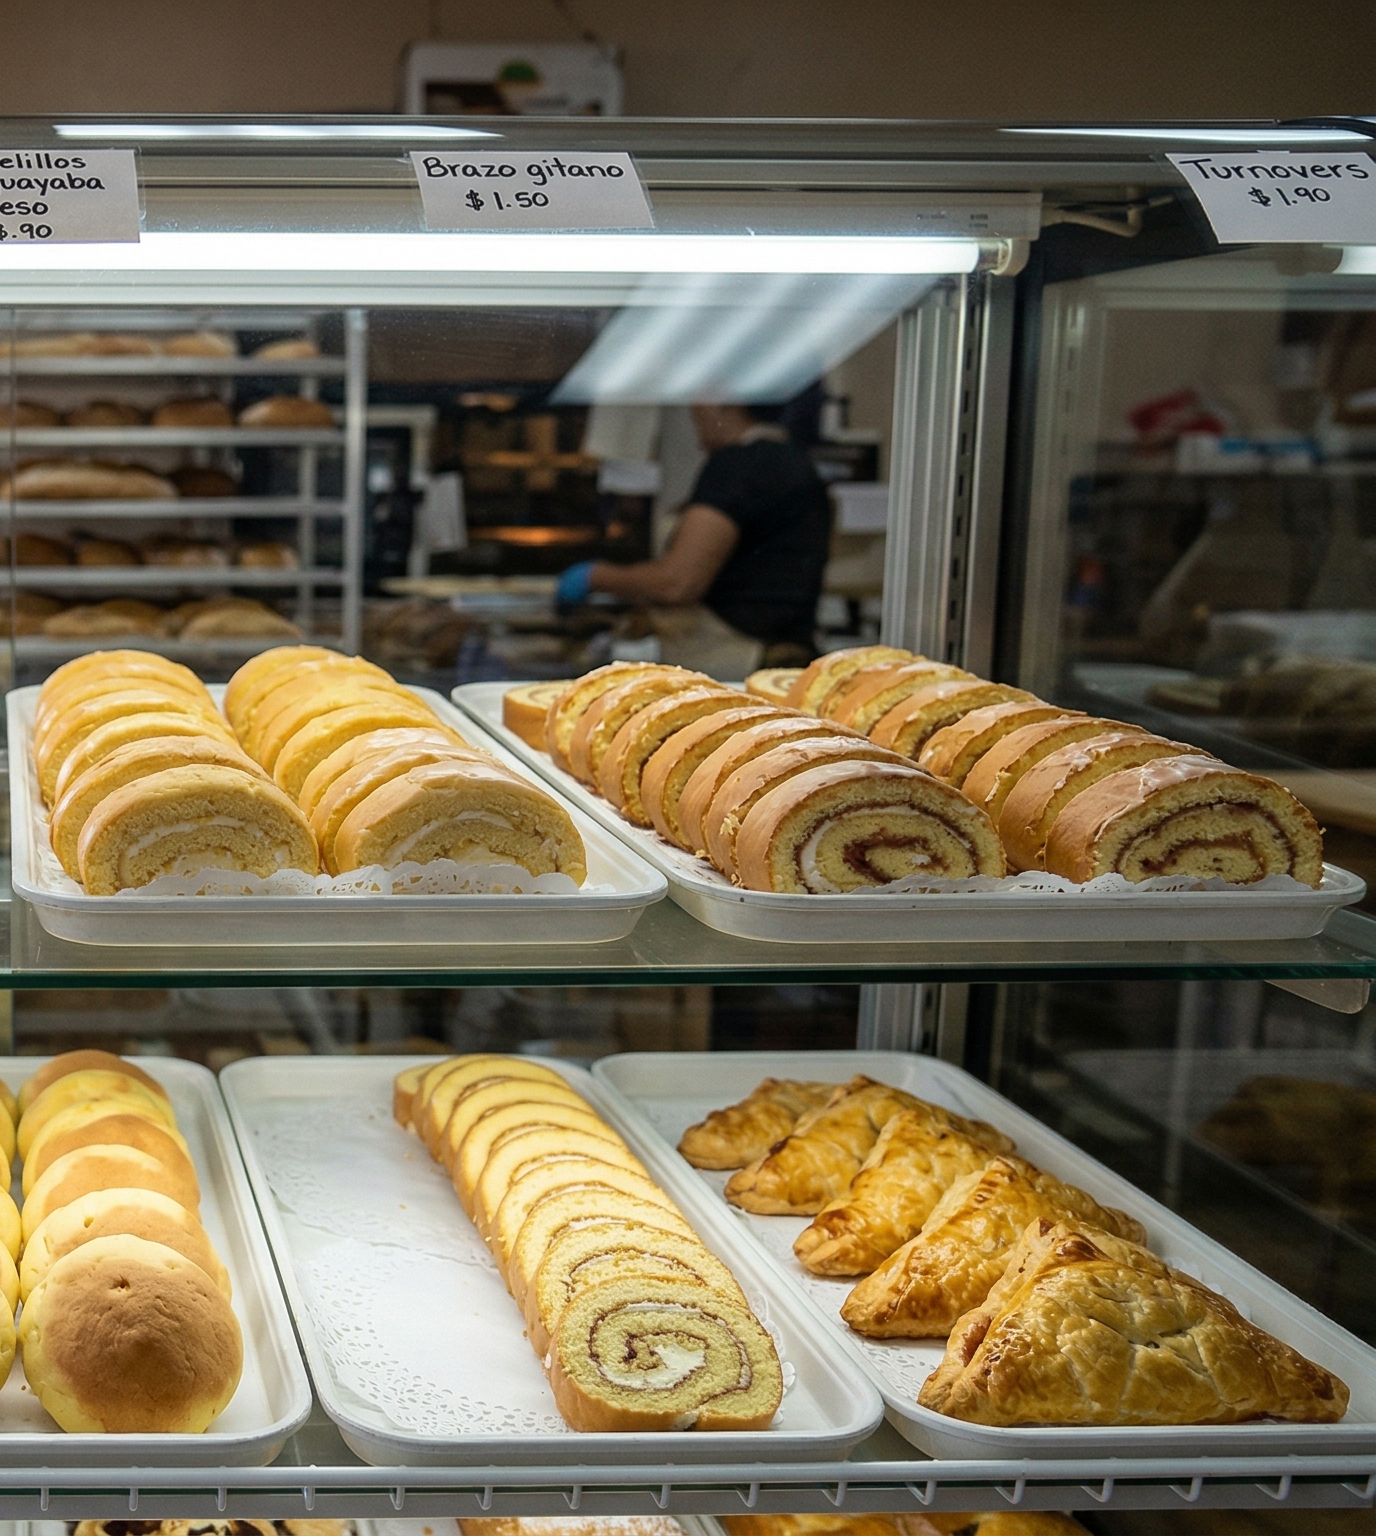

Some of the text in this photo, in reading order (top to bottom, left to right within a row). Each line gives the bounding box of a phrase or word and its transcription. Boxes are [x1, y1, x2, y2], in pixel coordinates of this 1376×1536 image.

[422, 156, 624, 186] Brazo gitano
[1179, 158, 1370, 180] Turnovers
